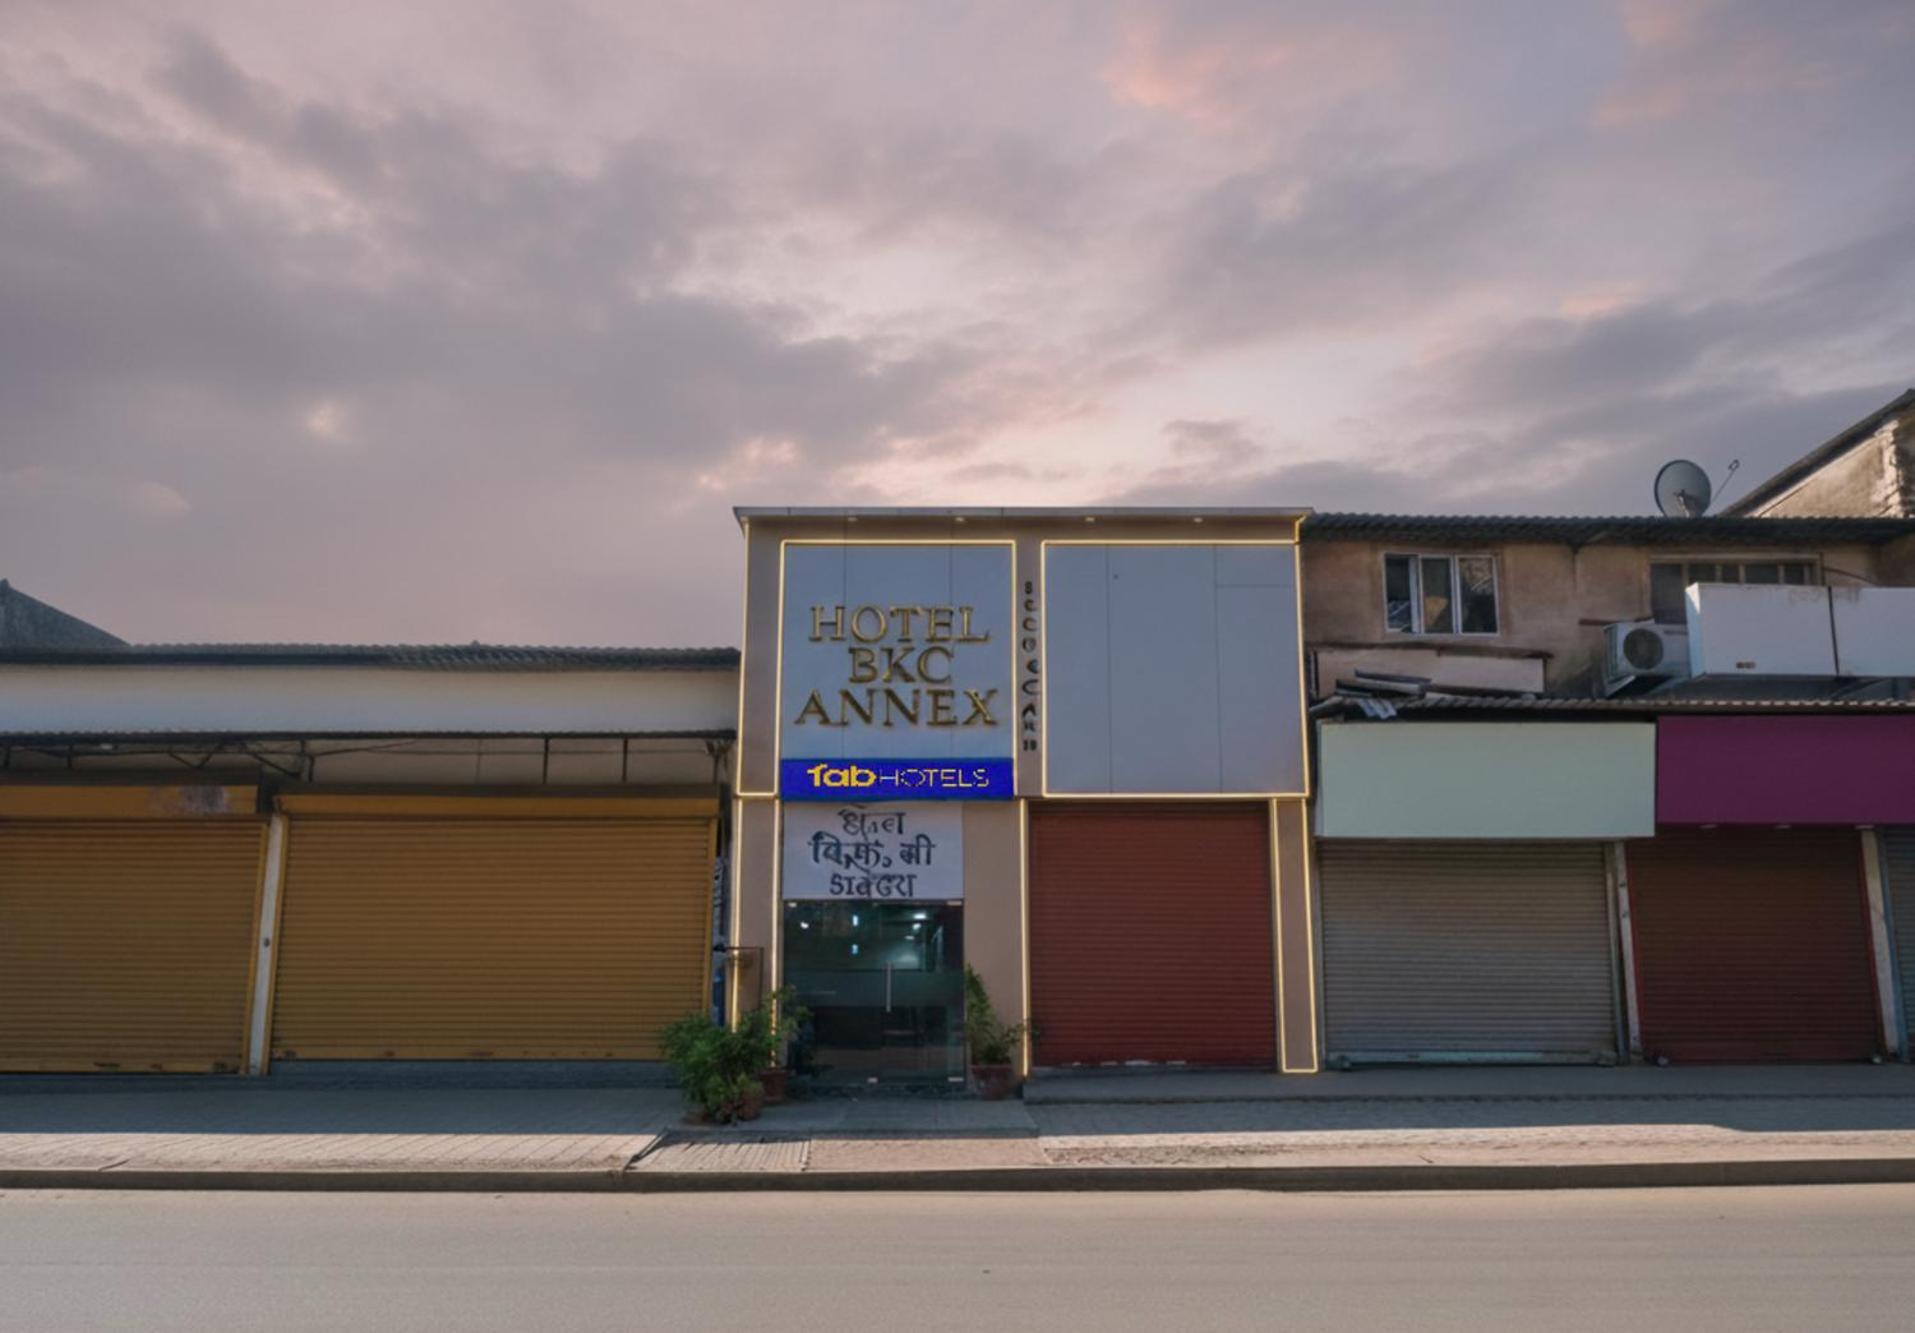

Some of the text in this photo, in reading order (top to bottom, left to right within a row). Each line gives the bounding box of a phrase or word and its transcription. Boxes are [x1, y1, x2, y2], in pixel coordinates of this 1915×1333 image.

[808, 606, 990, 642] HOTEL
[848, 646, 954, 683] BKC
[794, 688, 999, 726] ANNEX
